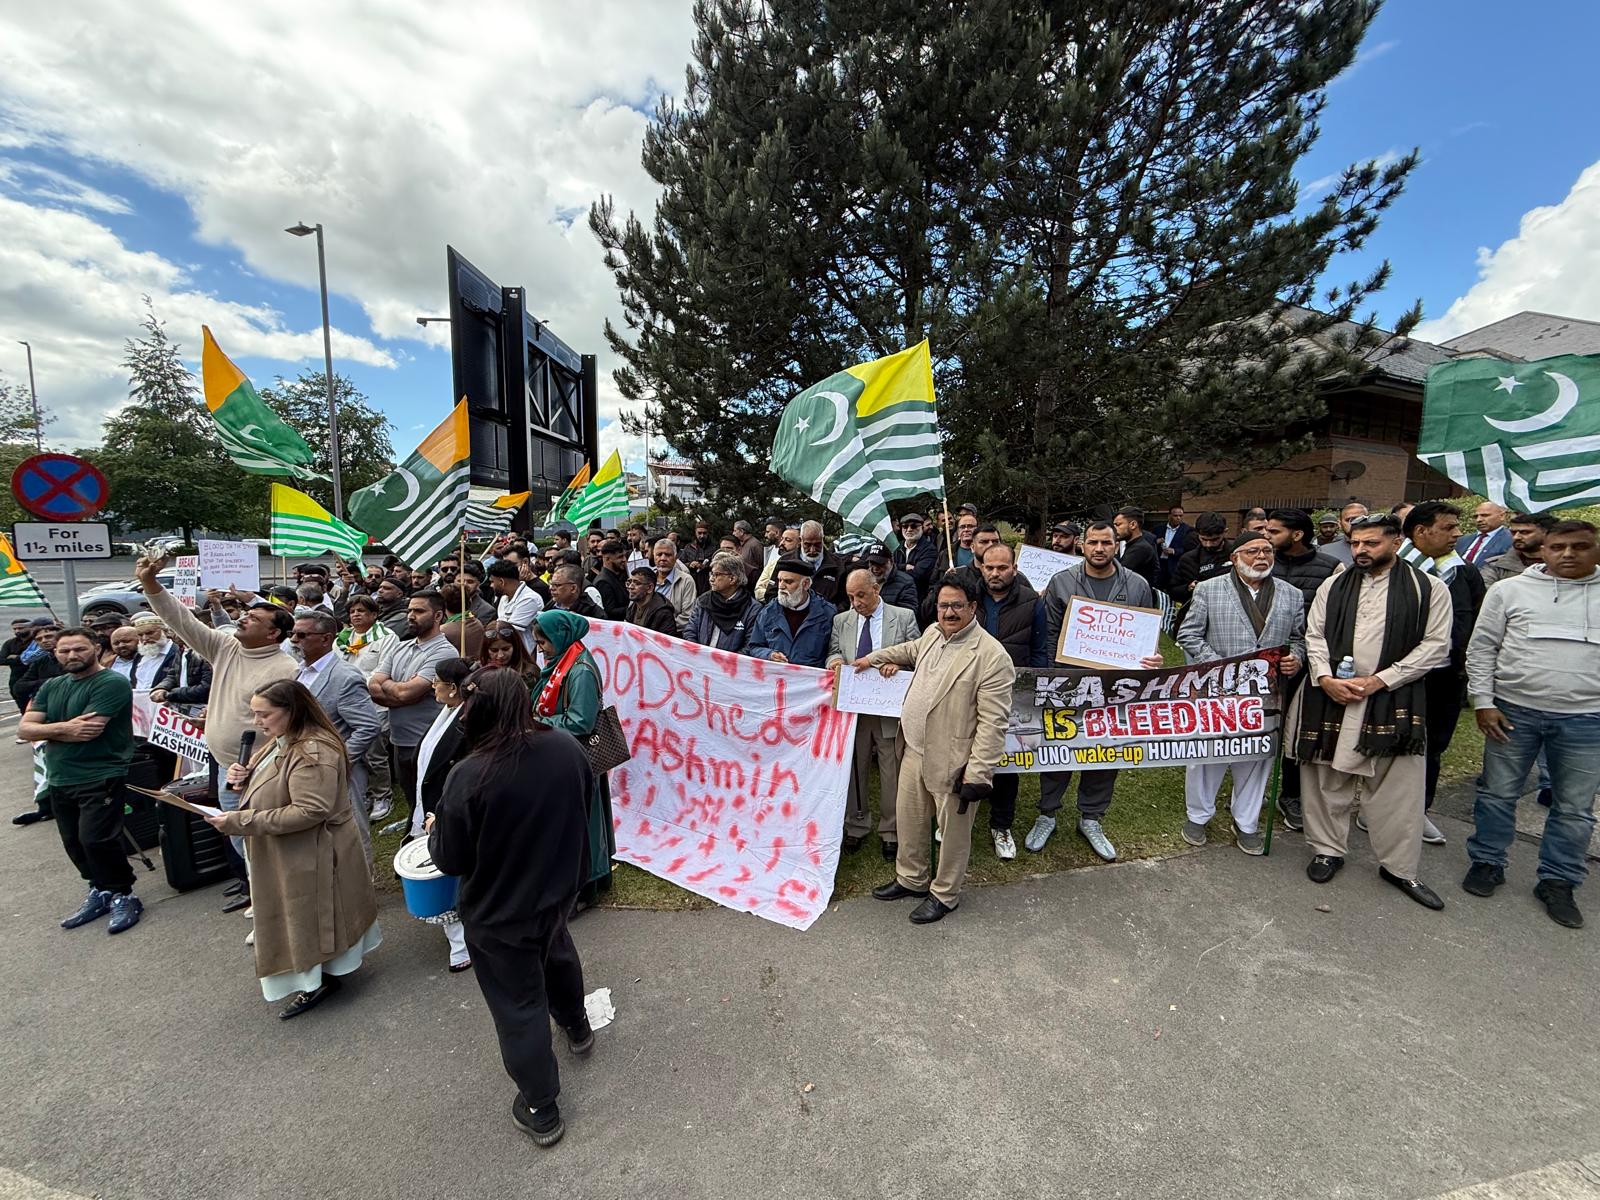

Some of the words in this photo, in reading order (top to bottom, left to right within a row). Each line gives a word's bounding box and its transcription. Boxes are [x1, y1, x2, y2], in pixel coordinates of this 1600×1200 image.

[48, 528, 80, 539] For
[54, 542, 104, 553] miles
[1021, 551, 1041, 560] OUR
[182, 587, 188, 595] OF
[1077, 605, 1135, 627] STOP
[1034, 659, 1271, 708] KASHMIR
[1042, 708, 1078, 740] IS
[1082, 696, 1265, 739] BLEEDING
[154, 725, 184, 739] INNOCENT
[152, 731, 210, 764] KASHMIR
[1038, 746, 1070, 766] UNO
[1075, 745, 1143, 765] wake-up
[1148, 741, 1208, 760] HUMAN
[1213, 735, 1271, 758] RIGHTS
